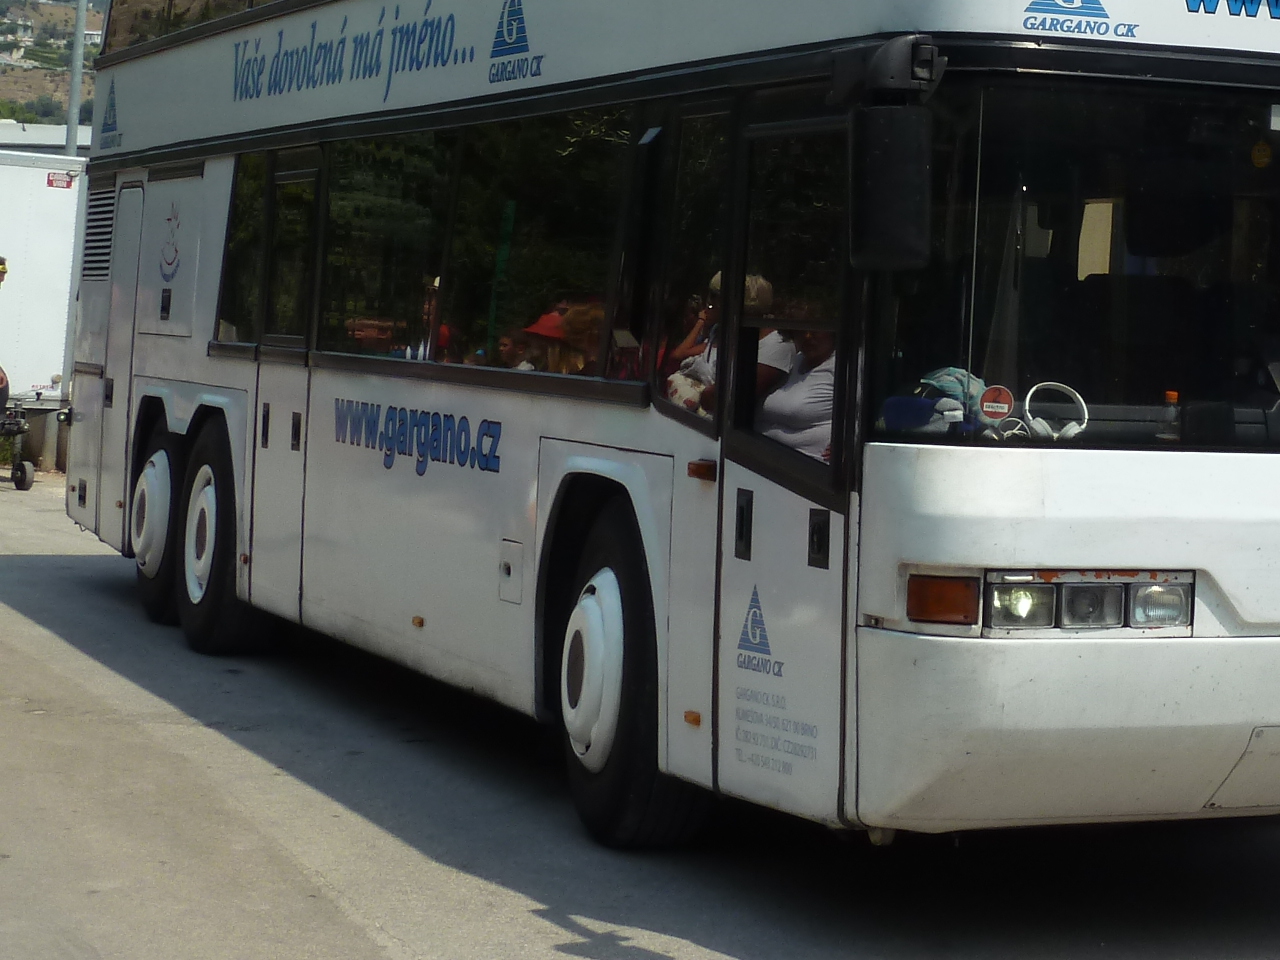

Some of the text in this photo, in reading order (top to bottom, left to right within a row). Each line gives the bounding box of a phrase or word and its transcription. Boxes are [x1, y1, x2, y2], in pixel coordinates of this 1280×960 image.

[1022, 15, 1140, 38] GARGANO CK
[233, 37, 266, 102] Vaše
[267, 14, 347, 97] dovolená
[350, 5, 386, 82] má
[489, 54, 544, 84] GARGANO CK
[334, 397, 502, 477] www.gargano.cz
[737, 652, 784, 677] GARGANO CK
